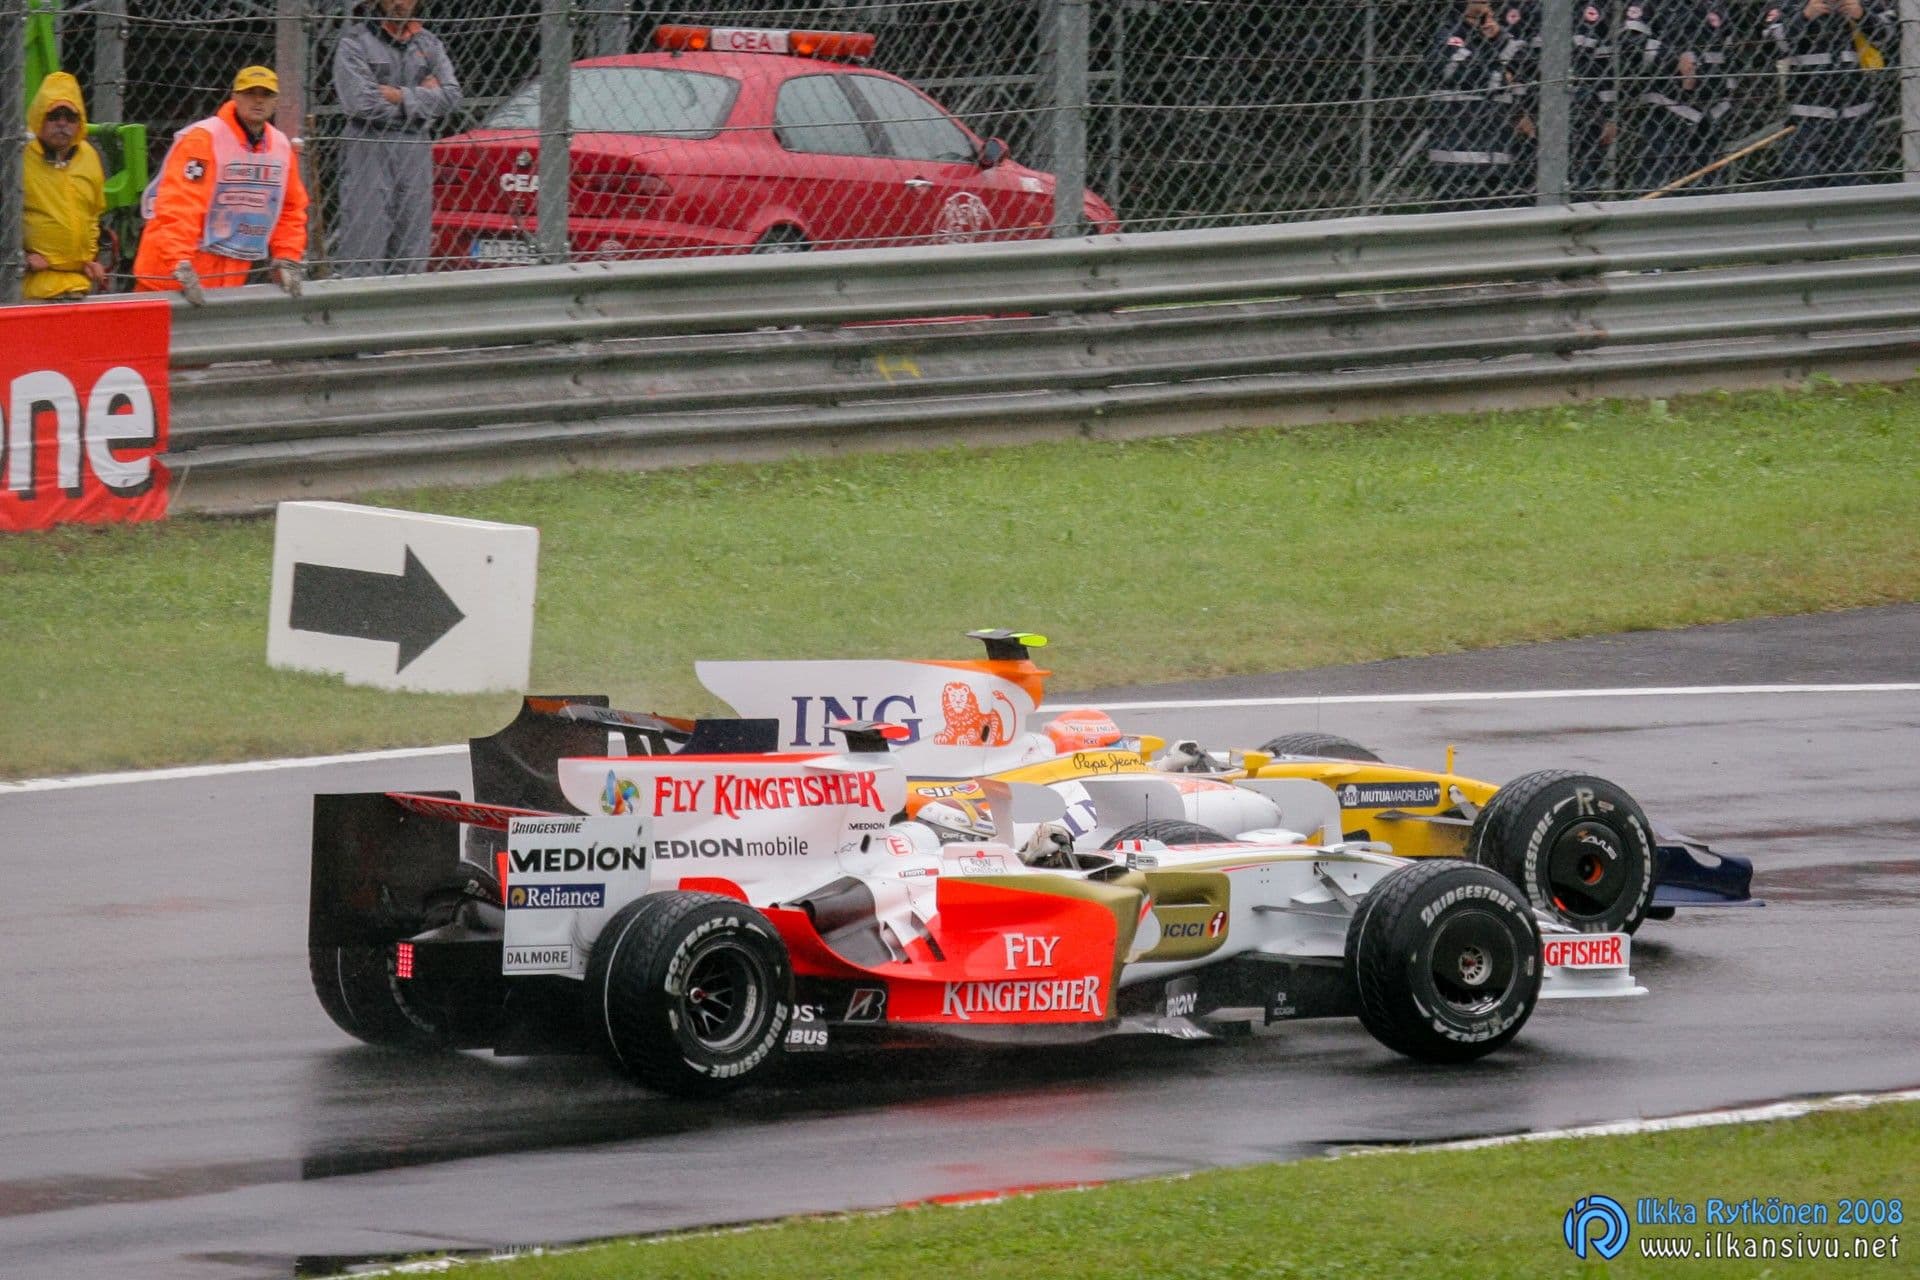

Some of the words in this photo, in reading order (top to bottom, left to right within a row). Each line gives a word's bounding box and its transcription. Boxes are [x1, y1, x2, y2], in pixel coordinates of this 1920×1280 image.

[729, 31, 772, 51] CEA
[0, 366, 158, 498] ne
[790, 695, 923, 746] ING
[1072, 752, 1109, 774] Pepe
[653, 776, 705, 817] FLY
[712, 771, 885, 820] KINGFISHER
[511, 822, 582, 834] BRIDGESTONE
[848, 822, 885, 831] MEDION
[508, 847, 647, 873] MEDION
[651, 837, 808, 860] EDIONmobile
[1525, 812, 1555, 910] RIDGESTONE
[527, 887, 600, 908] Reliance
[1420, 885, 1517, 928] BRIDGESTONE
[1163, 923, 1205, 937] ICICI
[507, 950, 568, 965] DALMORE
[664, 916, 740, 996] POTENZA
[1003, 932, 1061, 971] FLY
[942, 975, 1102, 1021] KINGFISHER
[710, 1002, 788, 1079] BRIDGESTONE
